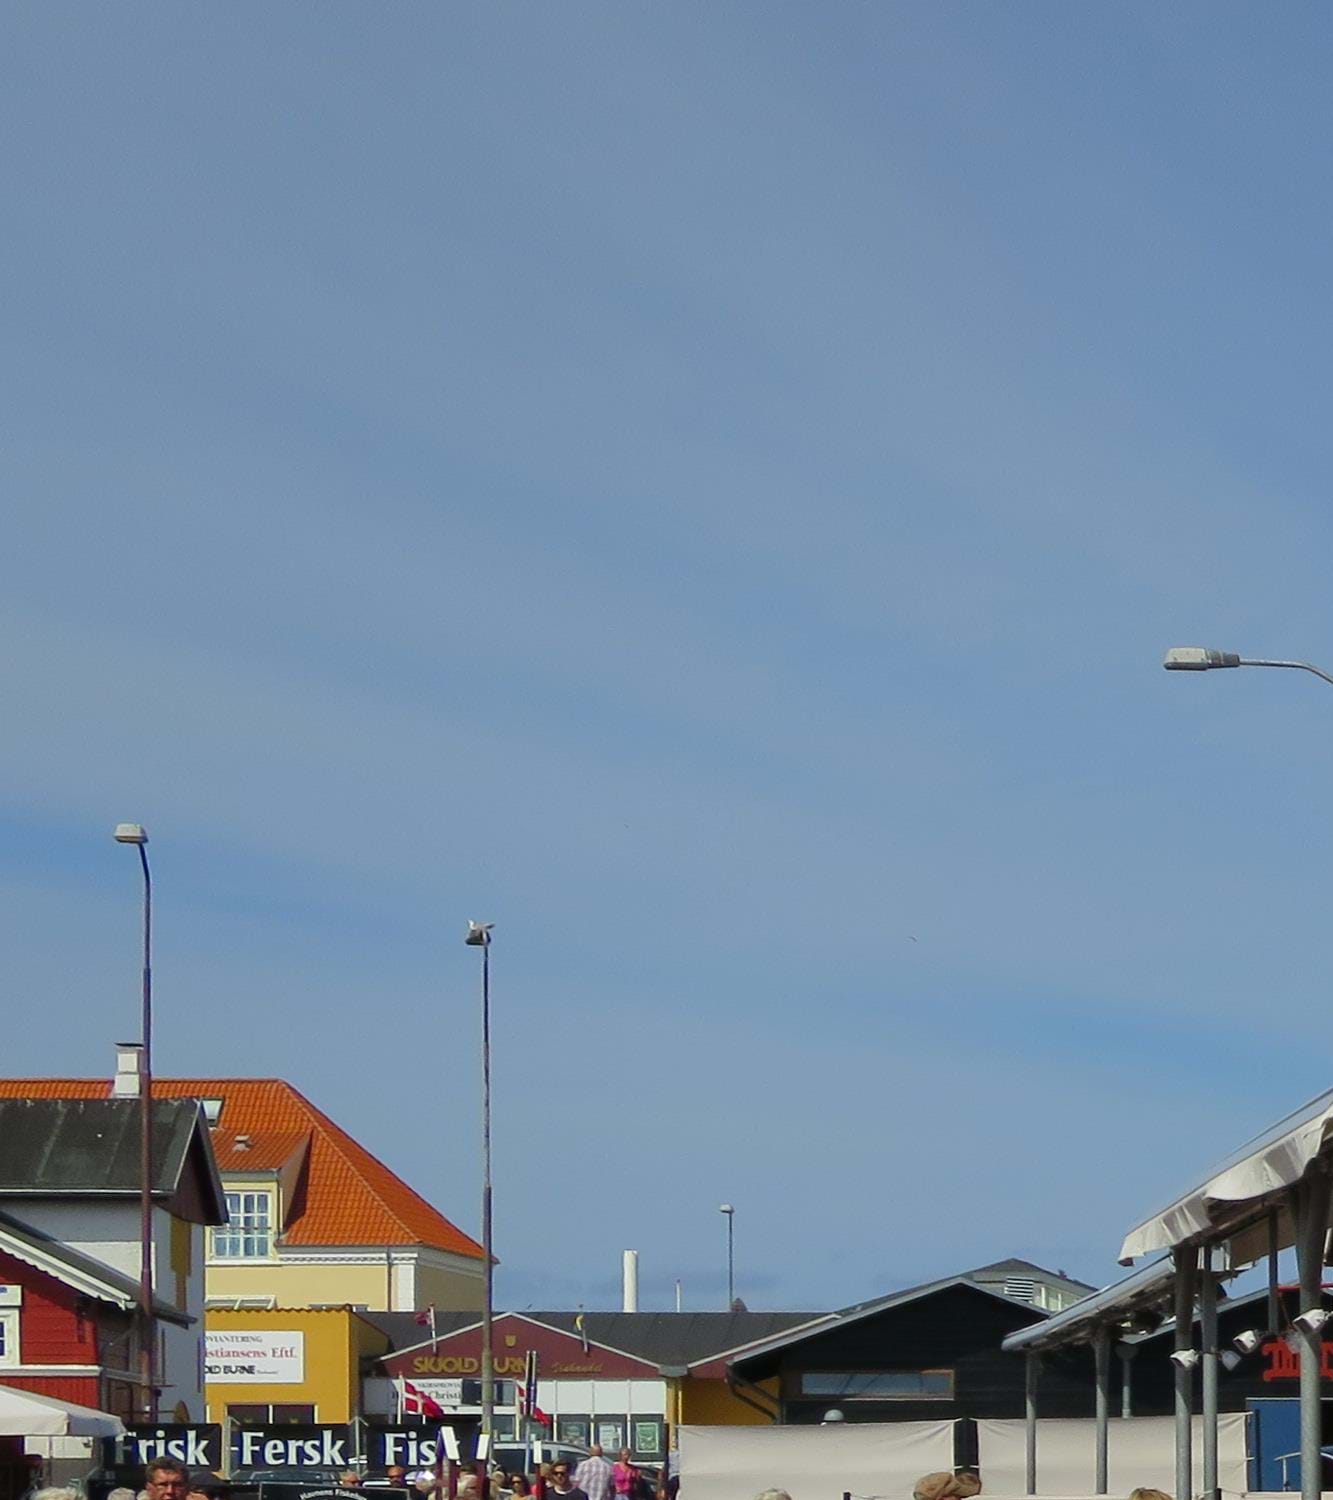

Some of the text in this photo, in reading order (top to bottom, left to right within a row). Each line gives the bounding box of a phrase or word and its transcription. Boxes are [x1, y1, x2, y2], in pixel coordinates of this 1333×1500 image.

[204, 1365, 221, 1375] OLD
[413, 1356, 478, 1374] SKJOLD
[493, 1356, 529, 1374] URN
[241, 1430, 347, 1466] Fersk
